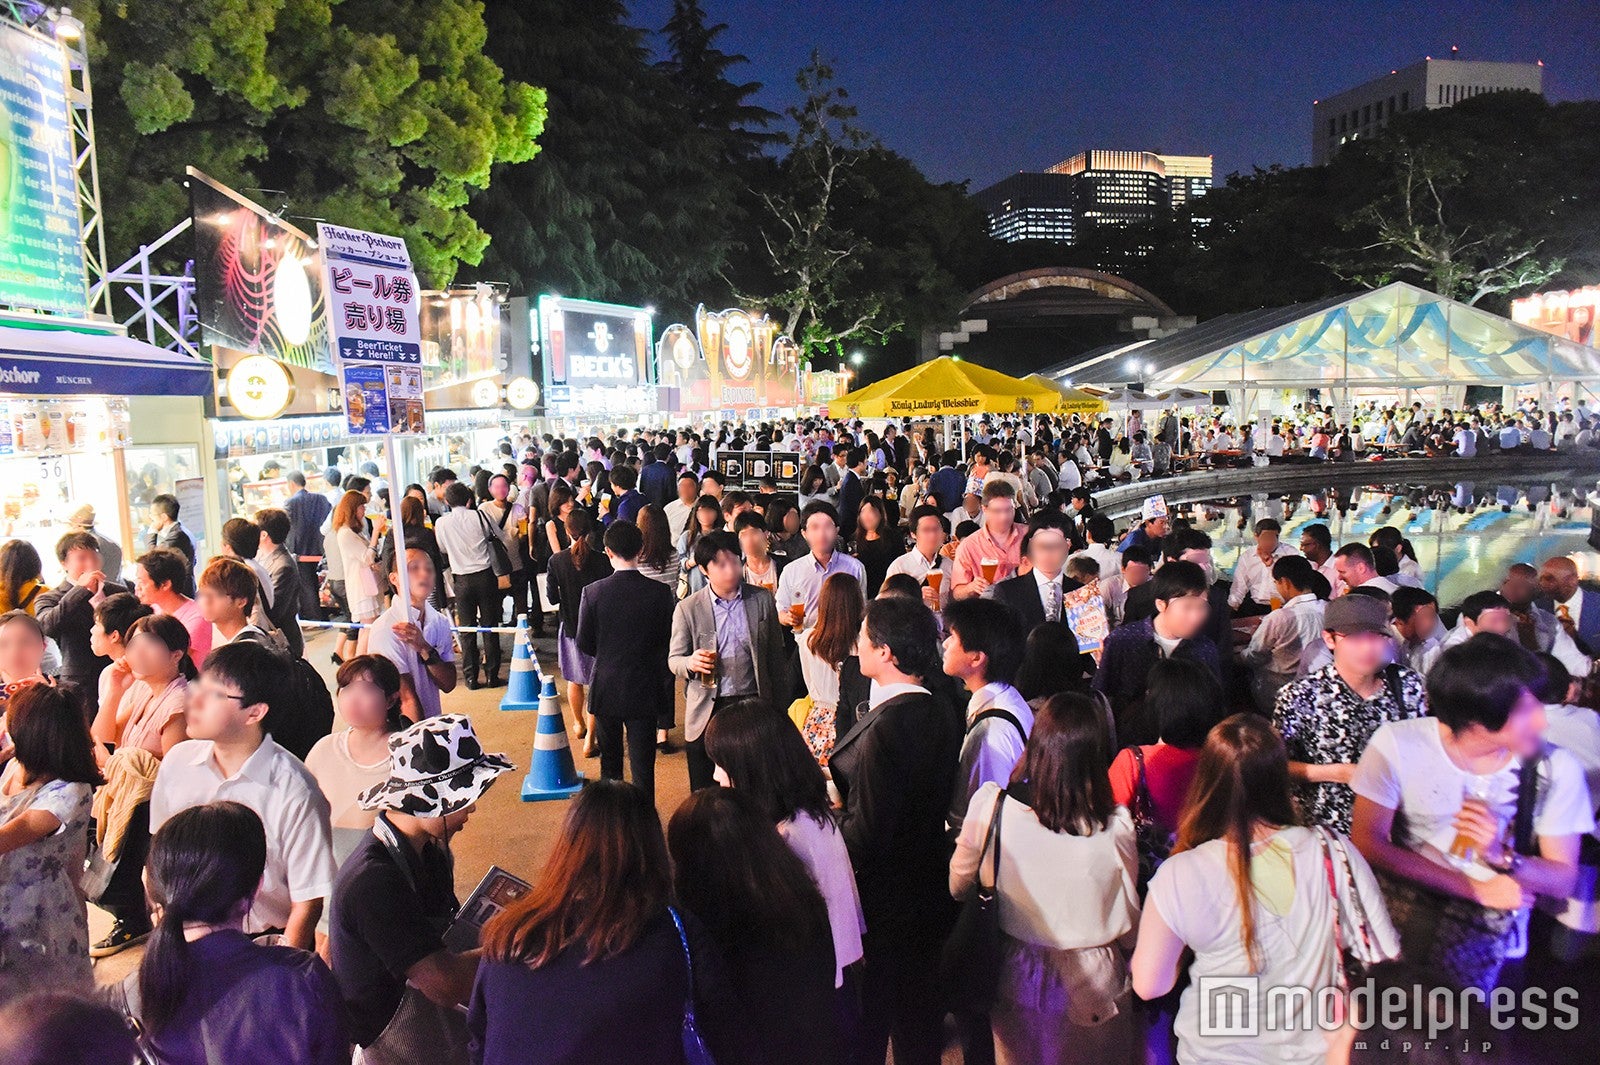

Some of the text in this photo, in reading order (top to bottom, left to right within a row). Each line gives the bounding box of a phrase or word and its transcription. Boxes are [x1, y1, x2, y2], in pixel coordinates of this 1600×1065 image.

[322, 226, 403, 250] Hacker-Pschorr
[331, 267, 413, 303] ビール券
[343, 301, 407, 335] 売り場
[368, 349, 394, 360] Here!!
[569, 353, 634, 378] BECK'S
[891, 398, 980, 412] König Ludwig Weissbier
